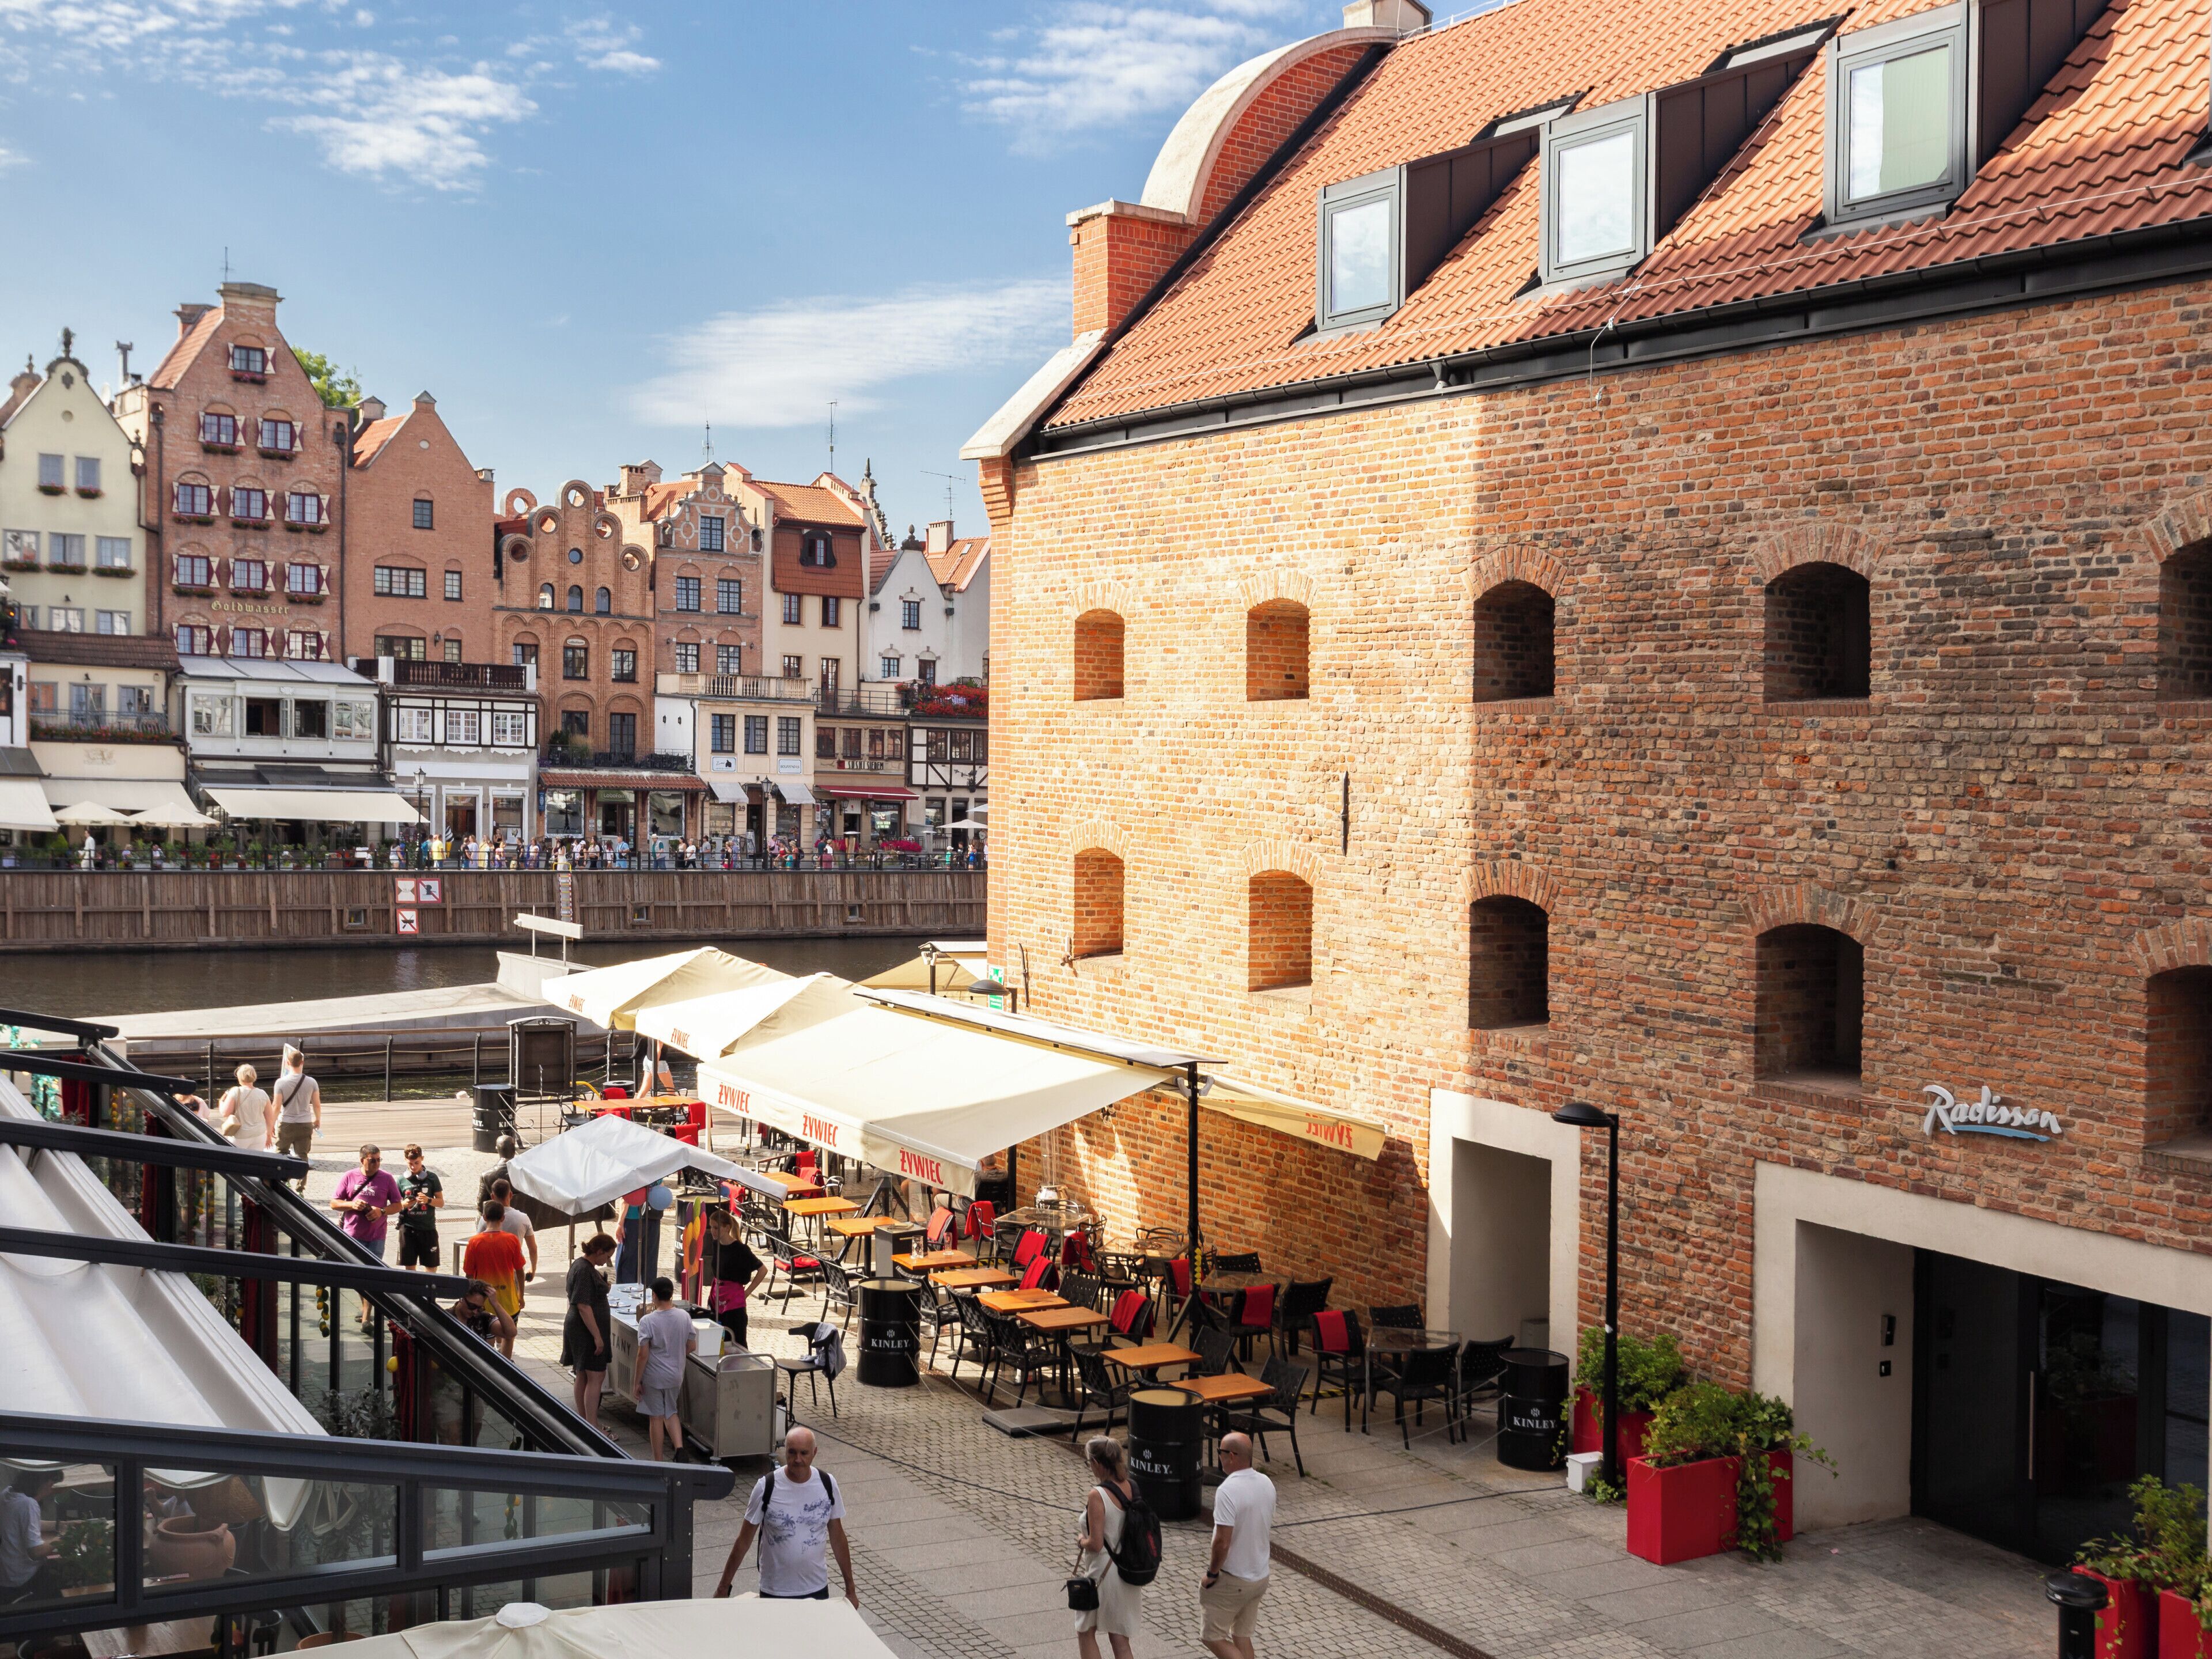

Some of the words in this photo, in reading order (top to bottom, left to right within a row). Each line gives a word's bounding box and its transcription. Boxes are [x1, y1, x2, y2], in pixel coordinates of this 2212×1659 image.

[211, 600, 289, 614] Goldwasser
[848, 760, 865, 770] SUSHI
[718, 1082, 751, 1113] ŻYWIEC
[1922, 1084, 2062, 1136] Radisson
[802, 1112, 839, 1147] ŻYWIEC
[900, 1147, 944, 1185] ŻYWIEC
[871, 1338, 909, 1348] KINLEY
[1513, 1416, 1556, 1429] KINLEY
[1131, 1456, 1171, 1474] KINLEY
